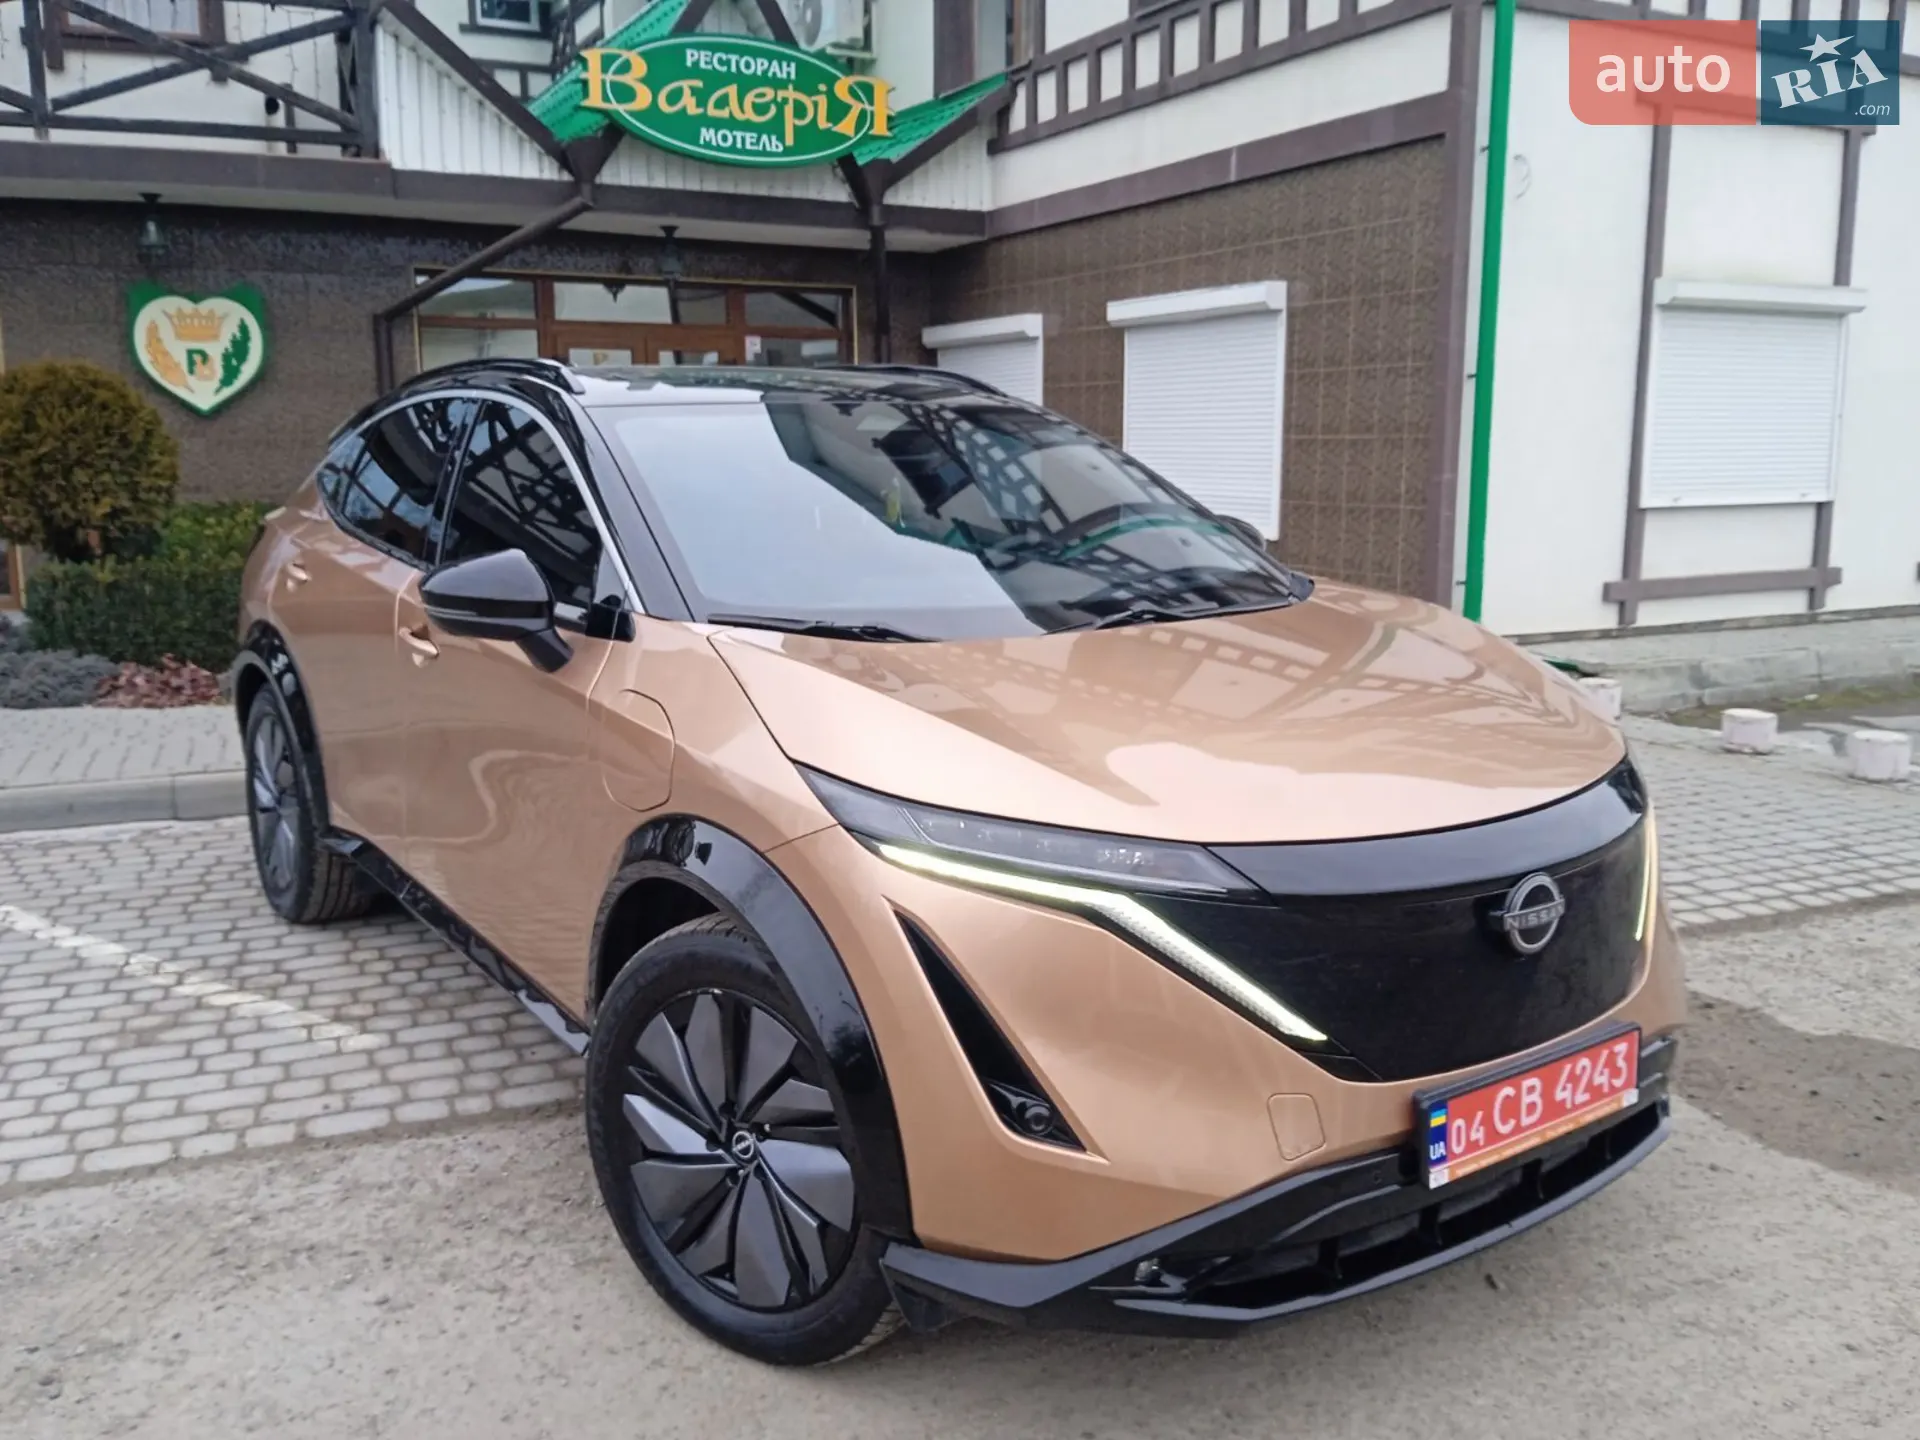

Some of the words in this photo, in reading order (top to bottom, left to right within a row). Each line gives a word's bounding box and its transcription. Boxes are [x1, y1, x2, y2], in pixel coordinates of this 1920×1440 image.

[686, 48, 796, 79] РЕСТОРАН
[700, 128, 784, 153] МОТЕЛЬ
[1451, 1111, 1484, 1154] 04
[1493, 1077, 1543, 1134] CB
[1554, 1042, 1629, 1109] 4243
[1430, 1144, 1446, 1160] UA
